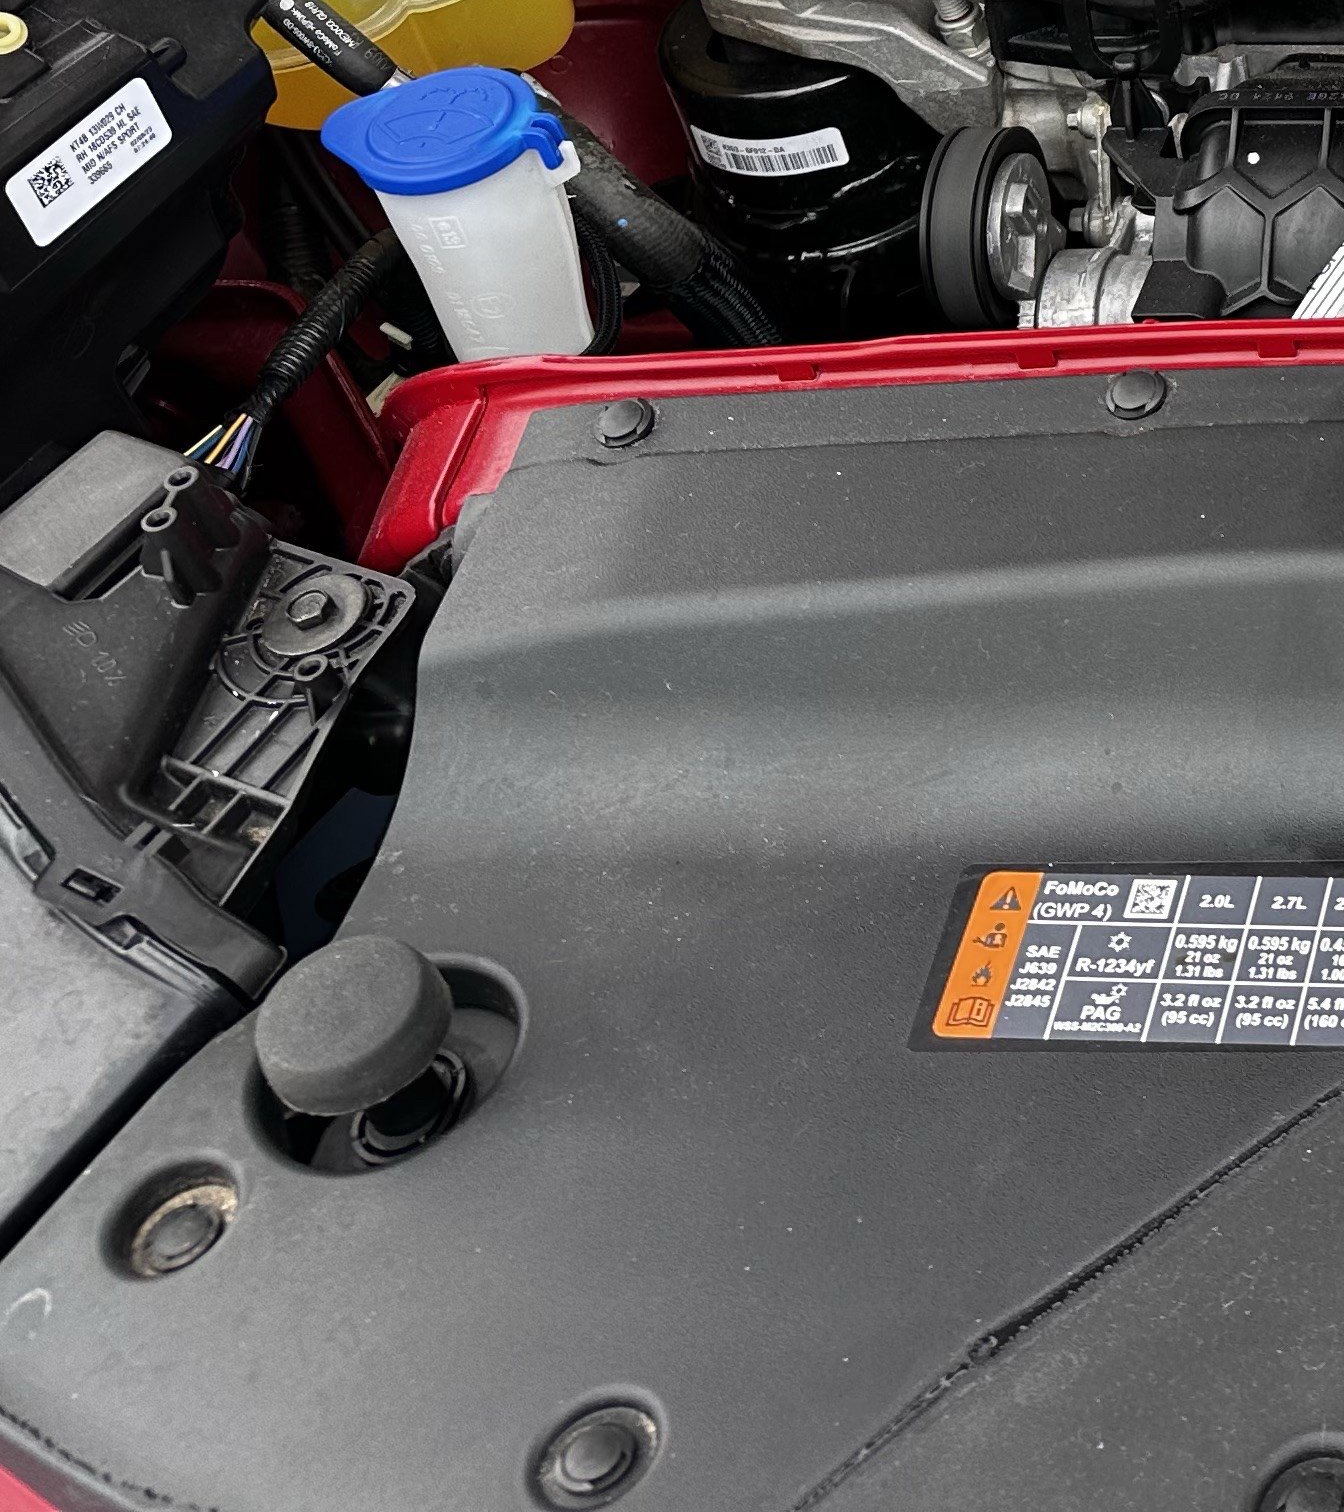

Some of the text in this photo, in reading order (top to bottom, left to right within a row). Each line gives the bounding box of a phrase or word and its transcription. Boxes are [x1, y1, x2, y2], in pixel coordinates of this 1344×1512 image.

[69, 133, 89, 153] KT4B
[114, 103, 127, 116] CH
[75, 152, 88, 164] RH
[117, 119, 128, 130] HL
[126, 106, 142, 121] SAE
[81, 158, 97, 174] MID
[117, 122, 140, 145] SPORT
[1043, 881, 1120, 897] FoMoCo
[1198, 894, 1235, 910] 2.0L
[1271, 896, 1308, 910] 2.7L
[1032, 902, 1112, 922] (GWP 4)
[1174, 933, 1240, 953] 0.595 kg
[1247, 935, 1312, 955] 0.595 kg
[1026, 945, 1062, 959] SAE
[1185, 951, 1221, 964] 21 oz
[1258, 953, 1294, 966] 21 oz
[1018, 962, 1058, 975] J639
[1075, 958, 1156, 977] R-1234yf
[1174, 966, 1225, 979] 1.31 lbs
[1248, 967, 1298, 980] 1.31 lbs
[1009, 978, 1057, 991] J2842
[1005, 994, 1052, 1008] J2845
[1160, 994, 1223, 1009] 3.2 fl oz
[1234, 995, 1296, 1010] 3.2 fl oz
[1306, 997, 1330, 1011] 5.4
[1080, 1005, 1122, 1021] PAG
[1161, 1010, 1215, 1028] (95 cc)
[1235, 1012, 1289, 1029] (95 cc)
[1304, 1013, 1339, 1031] (160
